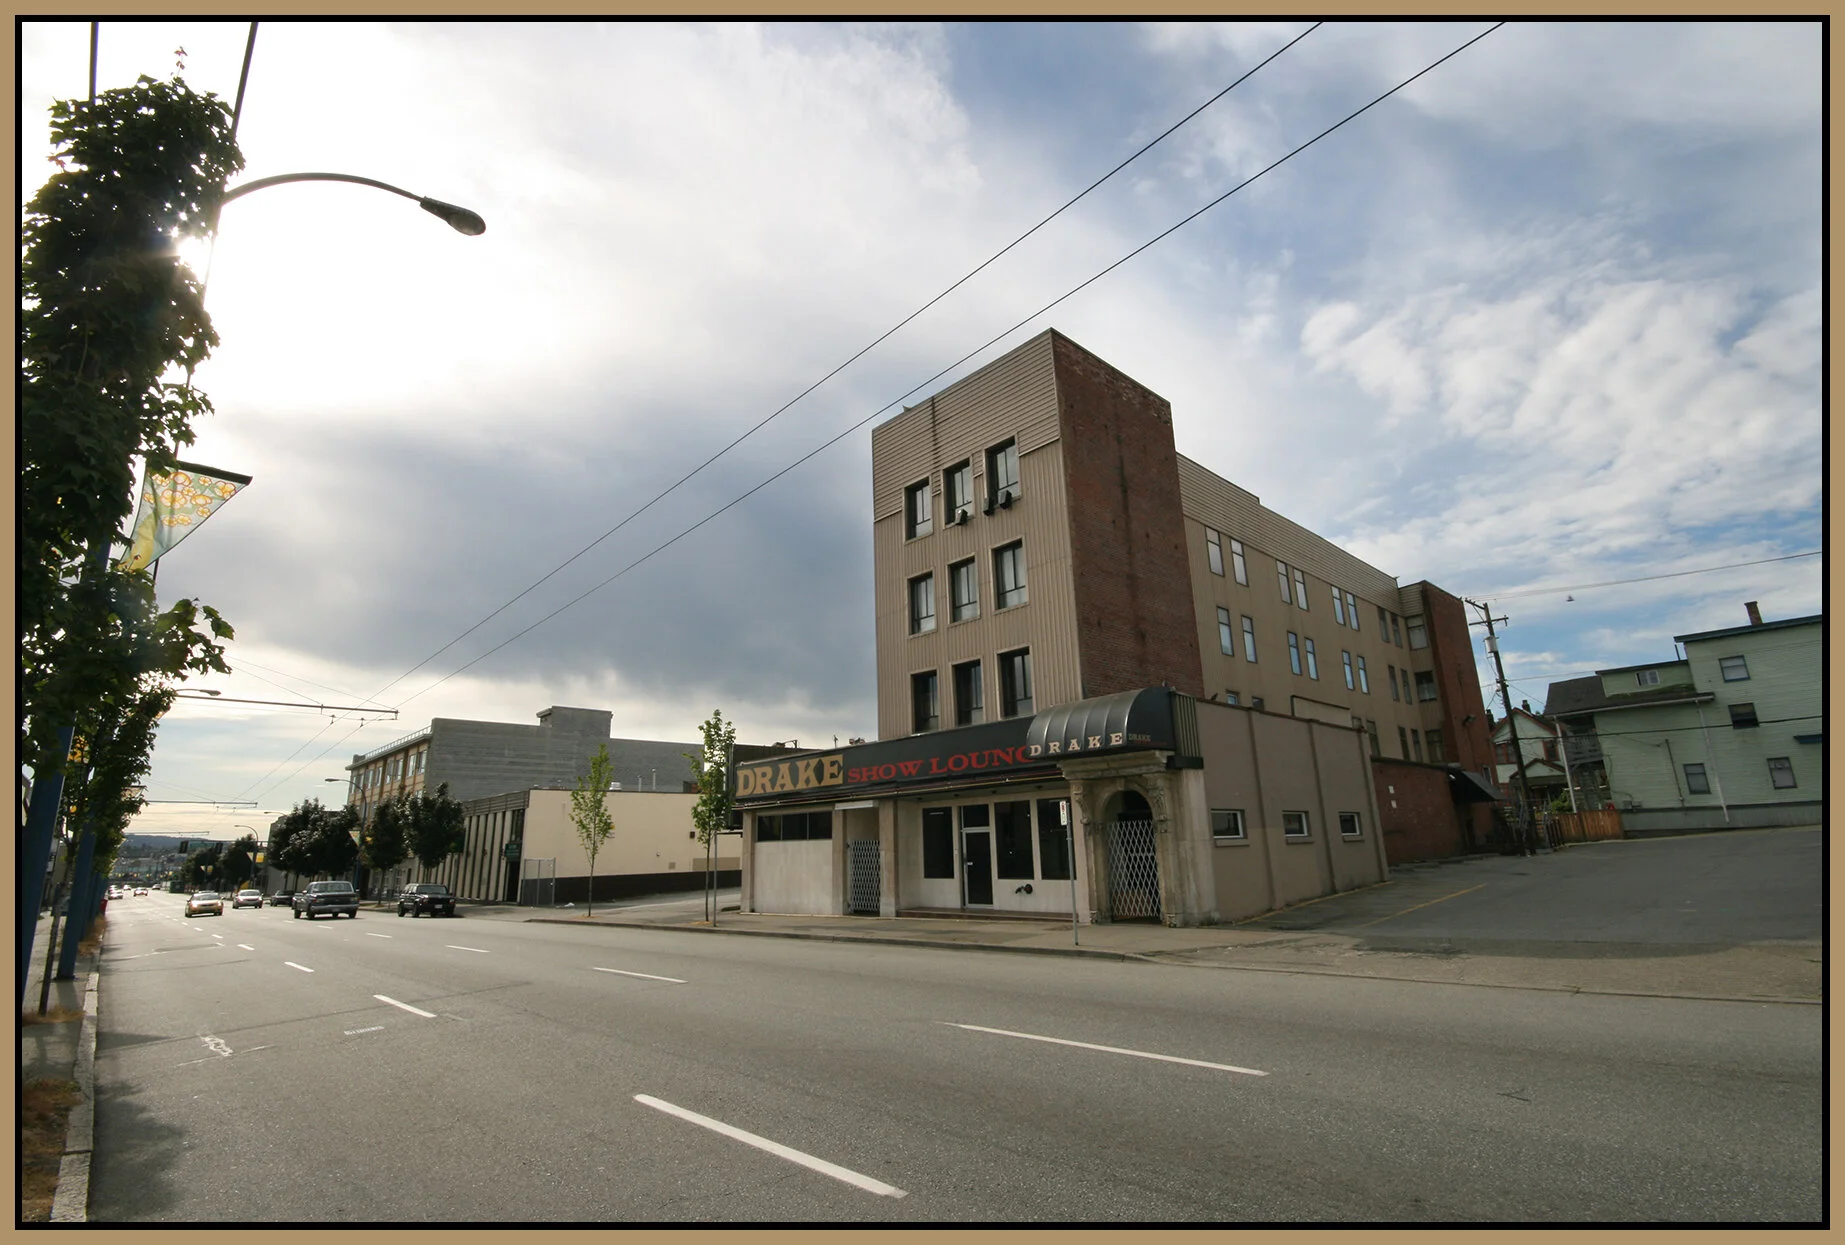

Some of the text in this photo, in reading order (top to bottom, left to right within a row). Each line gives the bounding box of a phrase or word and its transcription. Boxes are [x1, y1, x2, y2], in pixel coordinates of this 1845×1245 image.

[1029, 732, 1124, 757] DRAKE
[736, 754, 844, 797] DRAKE
[847, 759, 924, 783] SHOW
